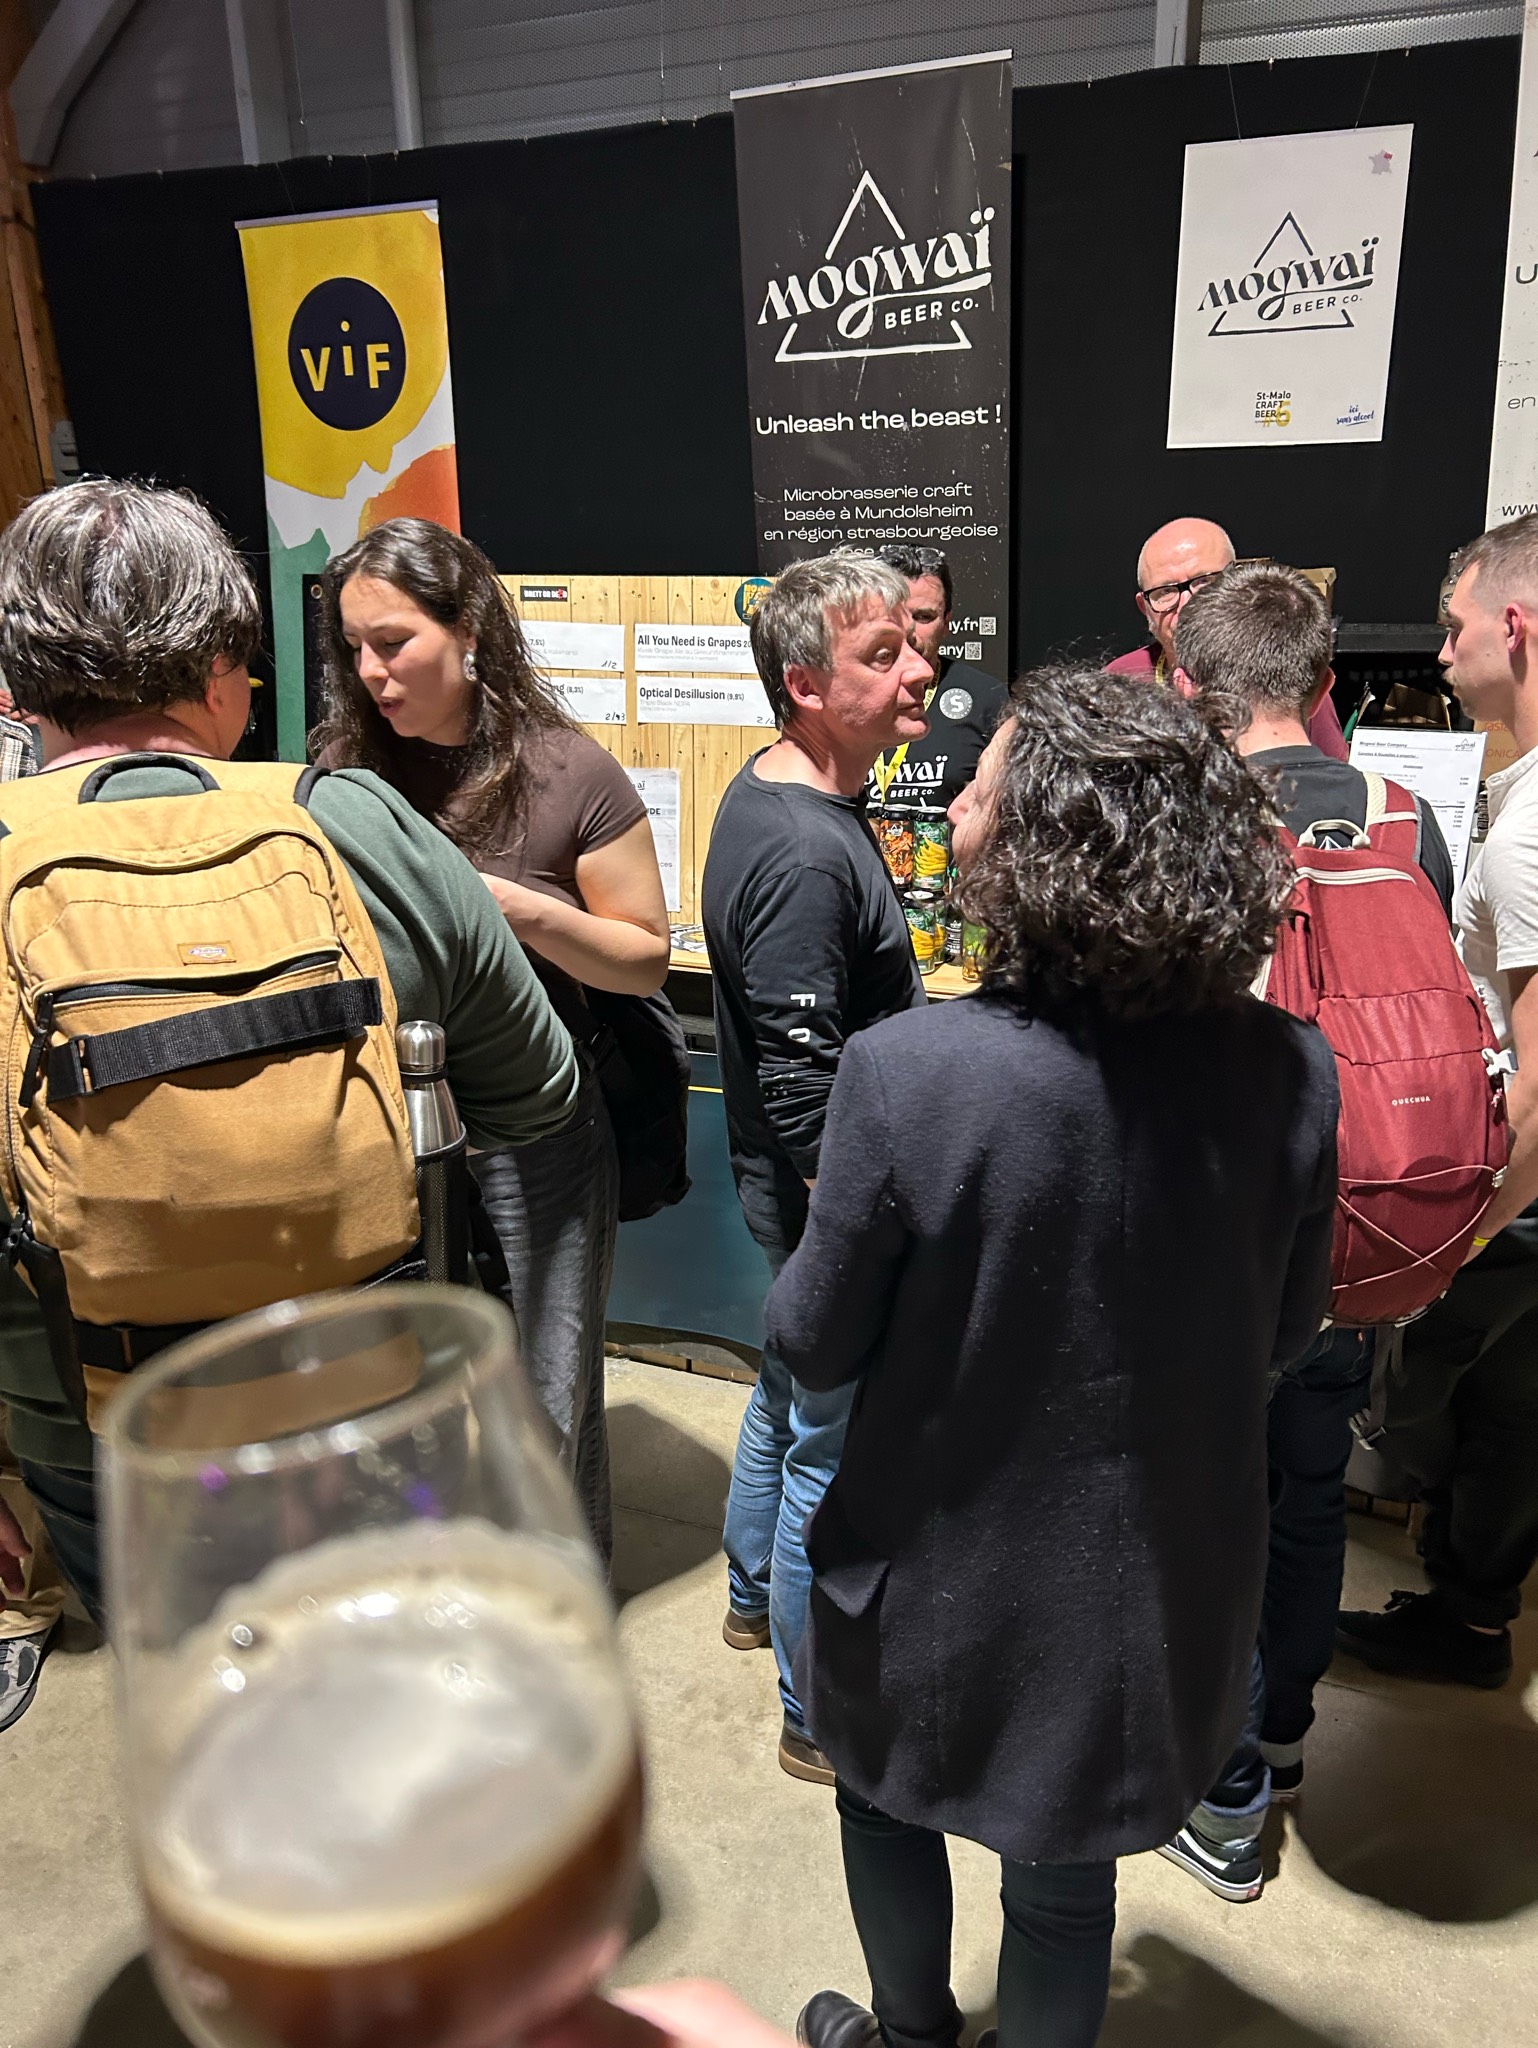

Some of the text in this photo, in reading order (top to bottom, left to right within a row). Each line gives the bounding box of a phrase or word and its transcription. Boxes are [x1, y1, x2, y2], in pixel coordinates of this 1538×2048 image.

[1292, 296, 1337, 314] BEER
[884, 304, 943, 330] BEER
[1256, 390, 1291, 400] St-Malo
[1508, 396, 1536, 409] en
[1255, 401, 1284, 409] CRAFT
[756, 404, 1002, 435] Unleash the beast !
[1255, 410, 1277, 418] BEER
[784, 482, 972, 501] Microbrasserie craft
[784, 503, 973, 522] basée à Mundolsheim
[764, 523, 998, 543] en région strasbourgeoise
[637, 635, 650, 646] All
[652, 635, 670, 646] You
[671, 636, 695, 647] Need
[697, 636, 705, 647] is
[708, 637, 742, 650] Grapes
[639, 687, 673, 700] Optical
[674, 688, 725, 700] Desillusion
[950, 695, 964, 712] S
[890, 789, 919, 798] BEER
[1391, 1095, 1431, 1106] QUECHUA
